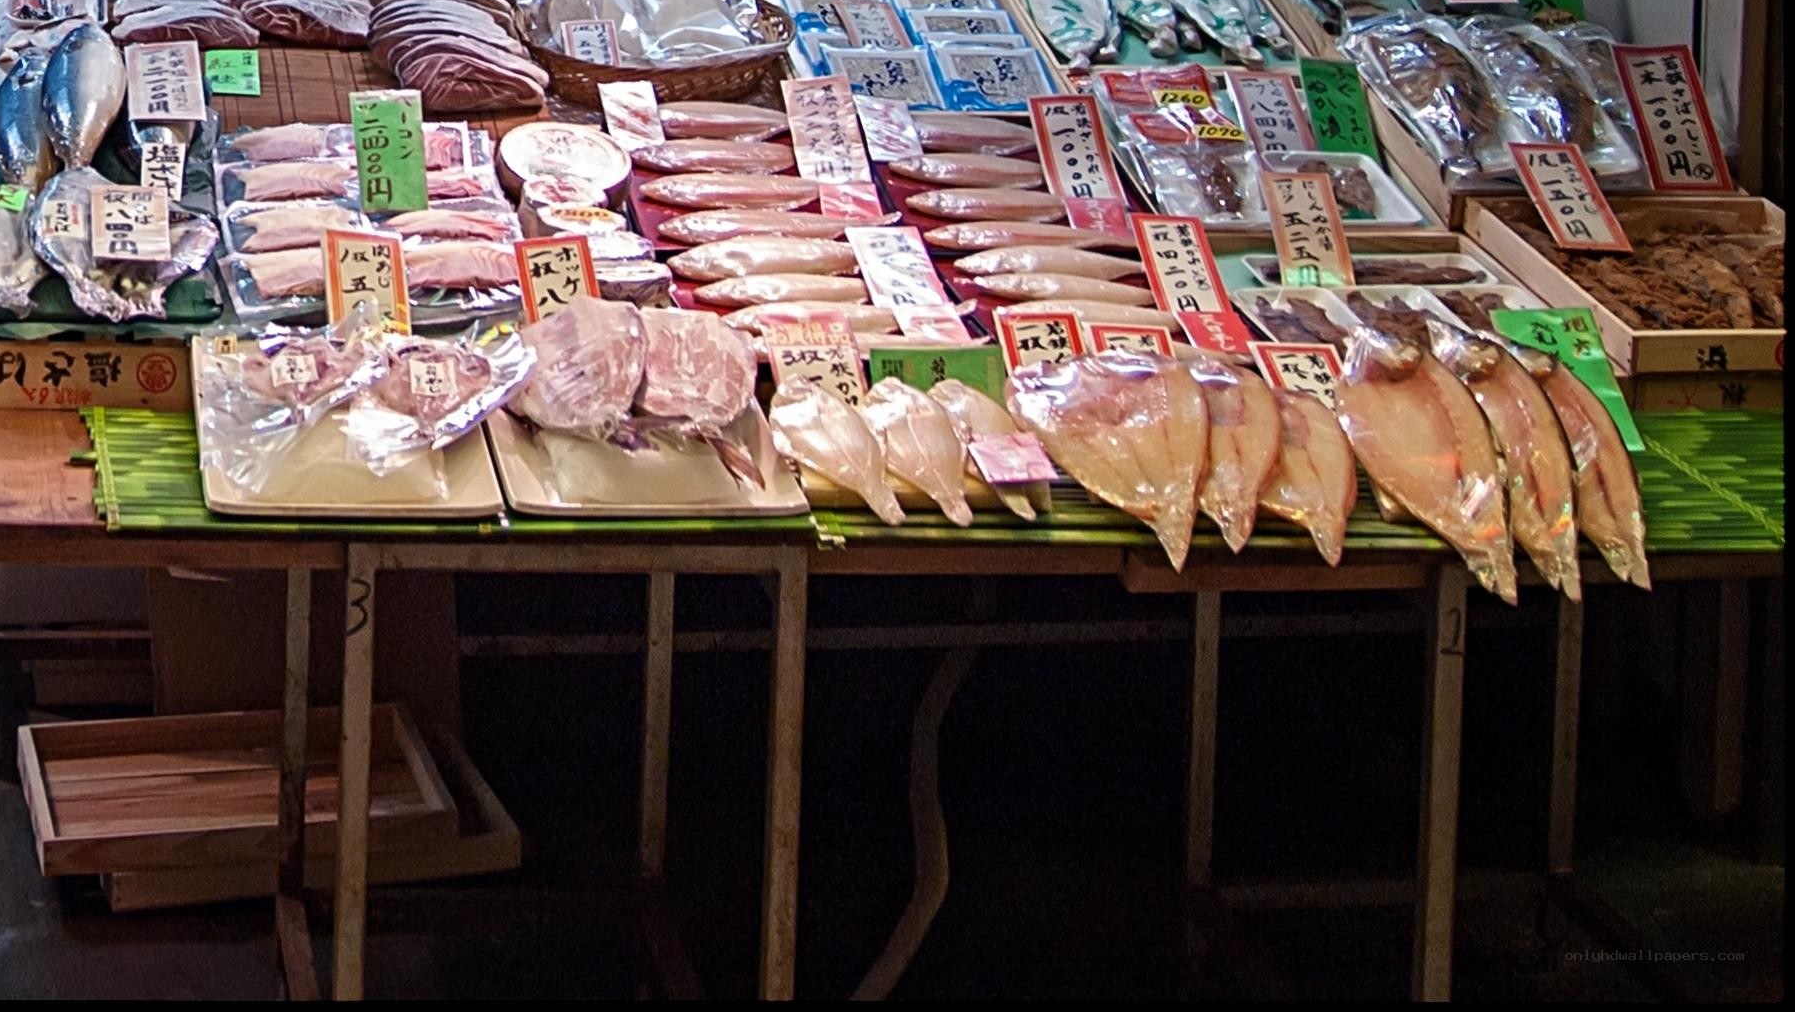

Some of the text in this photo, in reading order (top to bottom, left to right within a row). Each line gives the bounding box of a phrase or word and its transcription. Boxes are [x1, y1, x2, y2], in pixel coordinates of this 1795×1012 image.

[1159, 92, 1205, 104] 1260
[1197, 125, 1241, 137] 1070
[371, 244, 392, 289] 関あじ
[555, 247, 580, 297] ホッケ
[346, 578, 372, 637] 3
